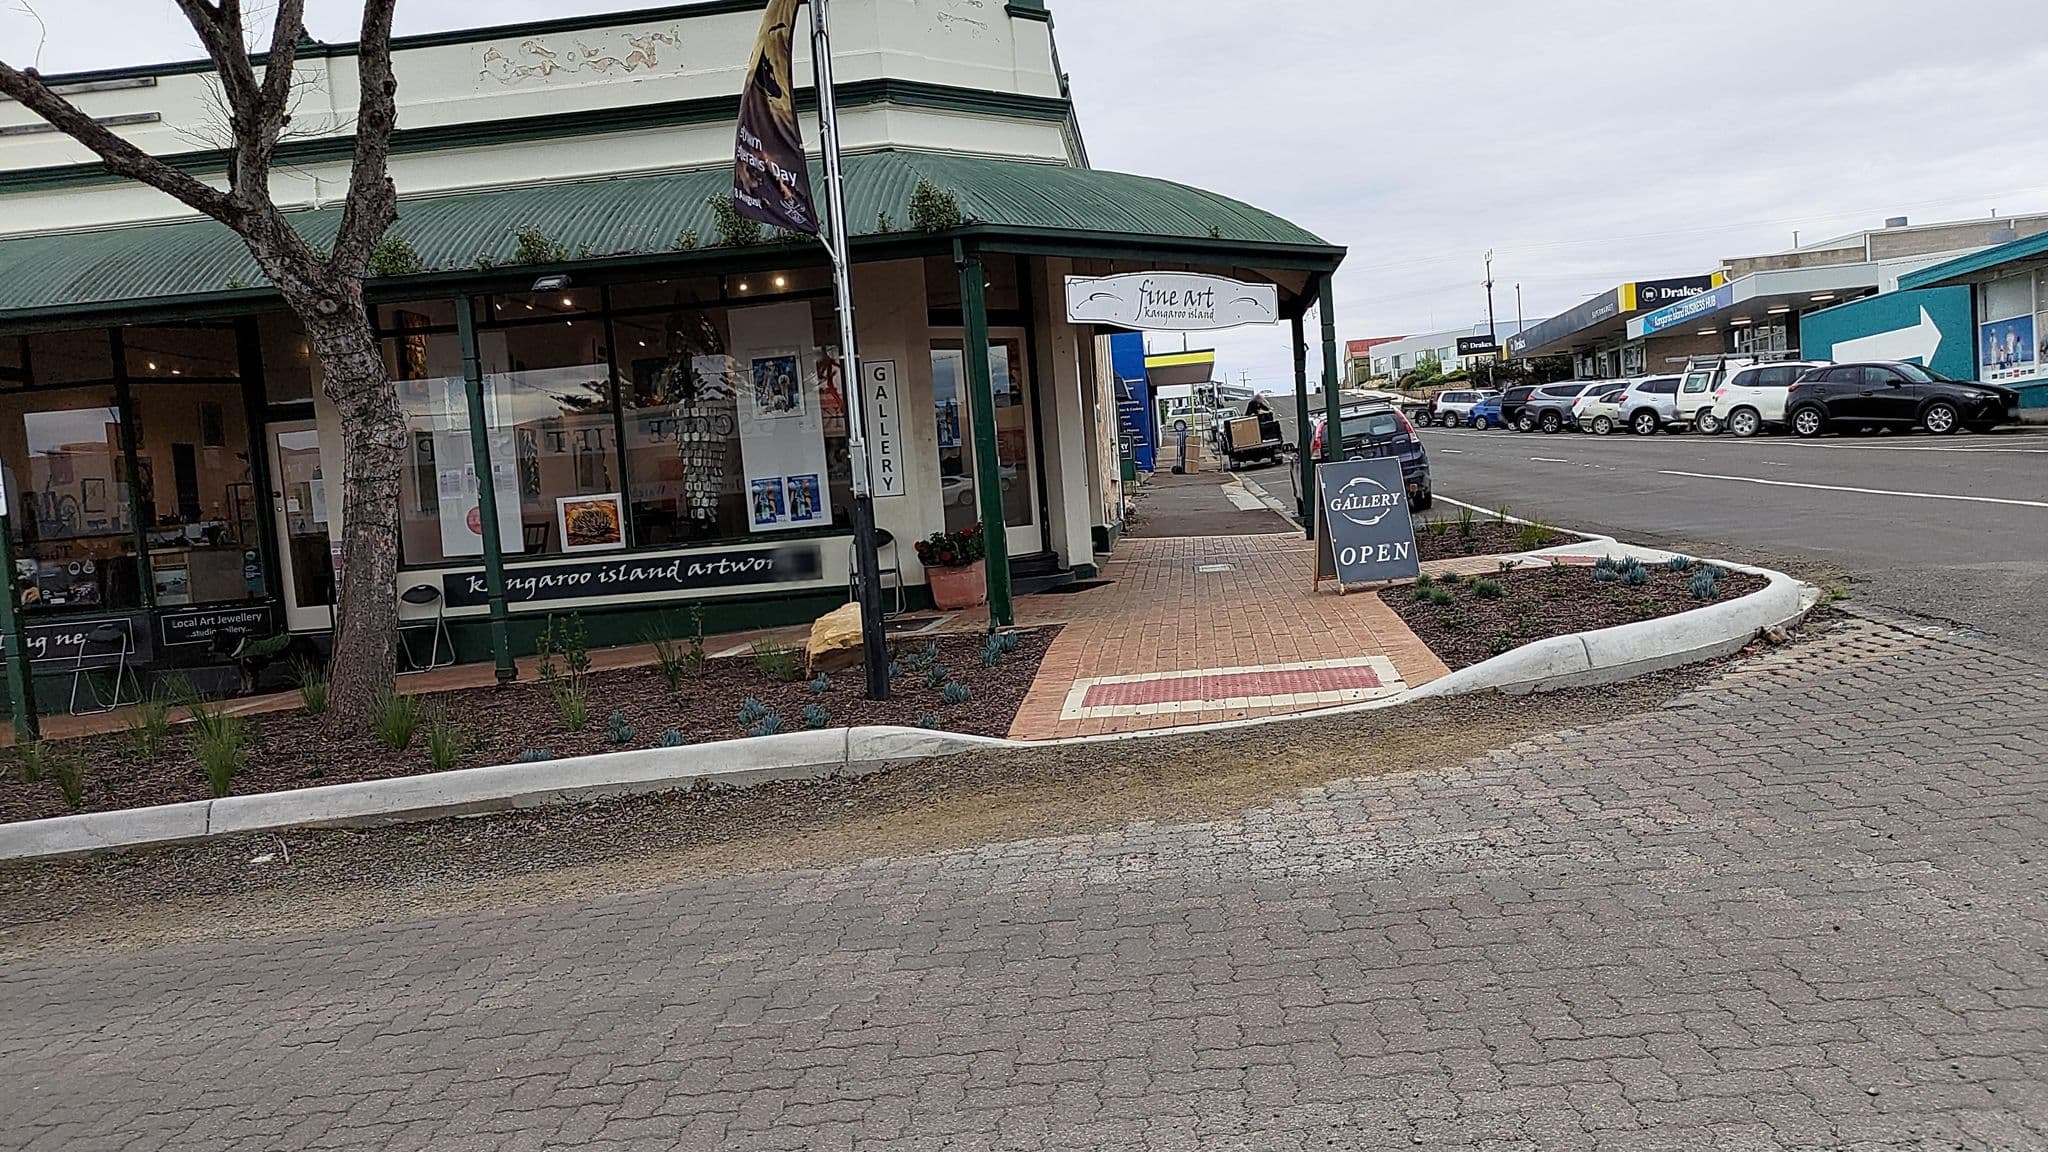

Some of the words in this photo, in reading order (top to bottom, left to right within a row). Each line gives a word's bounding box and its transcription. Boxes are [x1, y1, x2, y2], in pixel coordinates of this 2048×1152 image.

[771, 161, 797, 187] Day
[1134, 279, 1179, 321] fine
[1183, 286, 1215, 308] art
[1661, 286, 1703, 299] Drakes
[1706, 295, 1717, 310] HUB
[1144, 306, 1186, 325] kangaroo
[1188, 307, 1216, 323] island
[1469, 341, 1494, 349] Drakes
[873, 366, 893, 491] GALLERY
[1330, 493, 1400, 512] GALLERY
[1340, 542, 1411, 566] OPEN
[466, 573, 592, 600] kngaroo
[598, 559, 683, 584] island
[687, 557, 778, 577] artwor
[172, 617, 198, 629] Local
[199, 616, 216, 626] Art
[217, 612, 262, 624] Jewellery
[54, 632, 87, 645] ne
